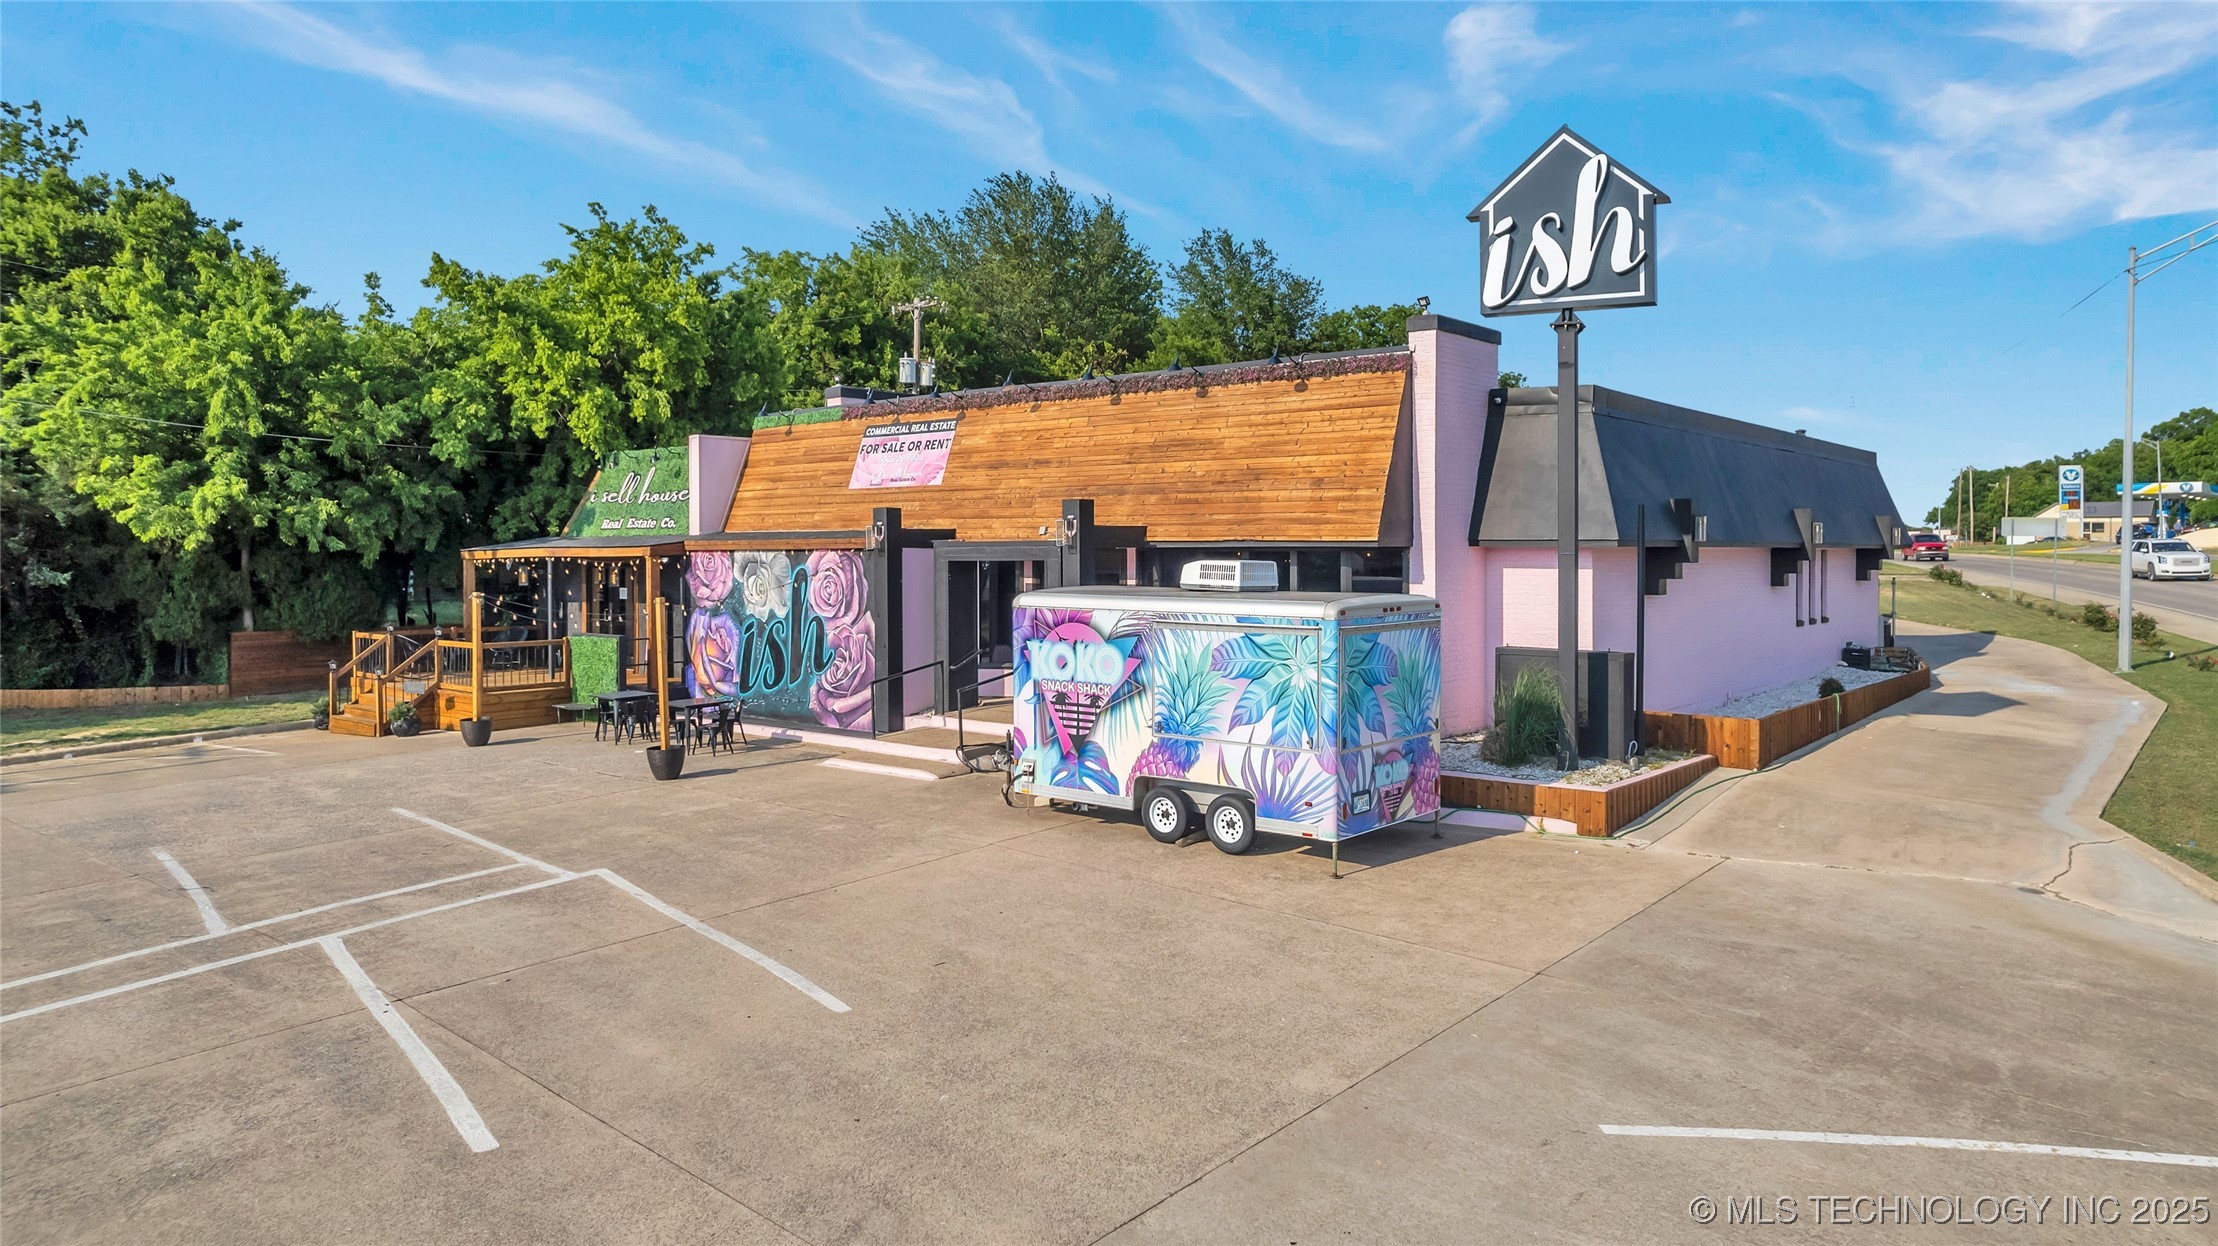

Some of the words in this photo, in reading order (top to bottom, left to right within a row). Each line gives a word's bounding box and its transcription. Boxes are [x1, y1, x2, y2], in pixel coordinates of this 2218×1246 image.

[1482, 154, 1647, 309] ish
[866, 425, 910, 436] COMMERCIAL
[911, 423, 928, 433] REAL
[930, 421, 957, 431] ESTATE
[860, 444, 880, 454] FOR
[881, 441, 906, 453] SALE
[907, 440, 922, 451] OR
[923, 438, 952, 450] RENT
[590, 490, 598, 503] i
[601, 472, 641, 504] sell
[601, 518, 624, 529] Real
[626, 518, 656, 529] Estate
[661, 517, 676, 528] Co.
[738, 564, 835, 696] ish
[1027, 640, 1124, 686] KOKO
[1041, 680, 1075, 693] SNACK
[1077, 682, 1111, 696] SHACK
